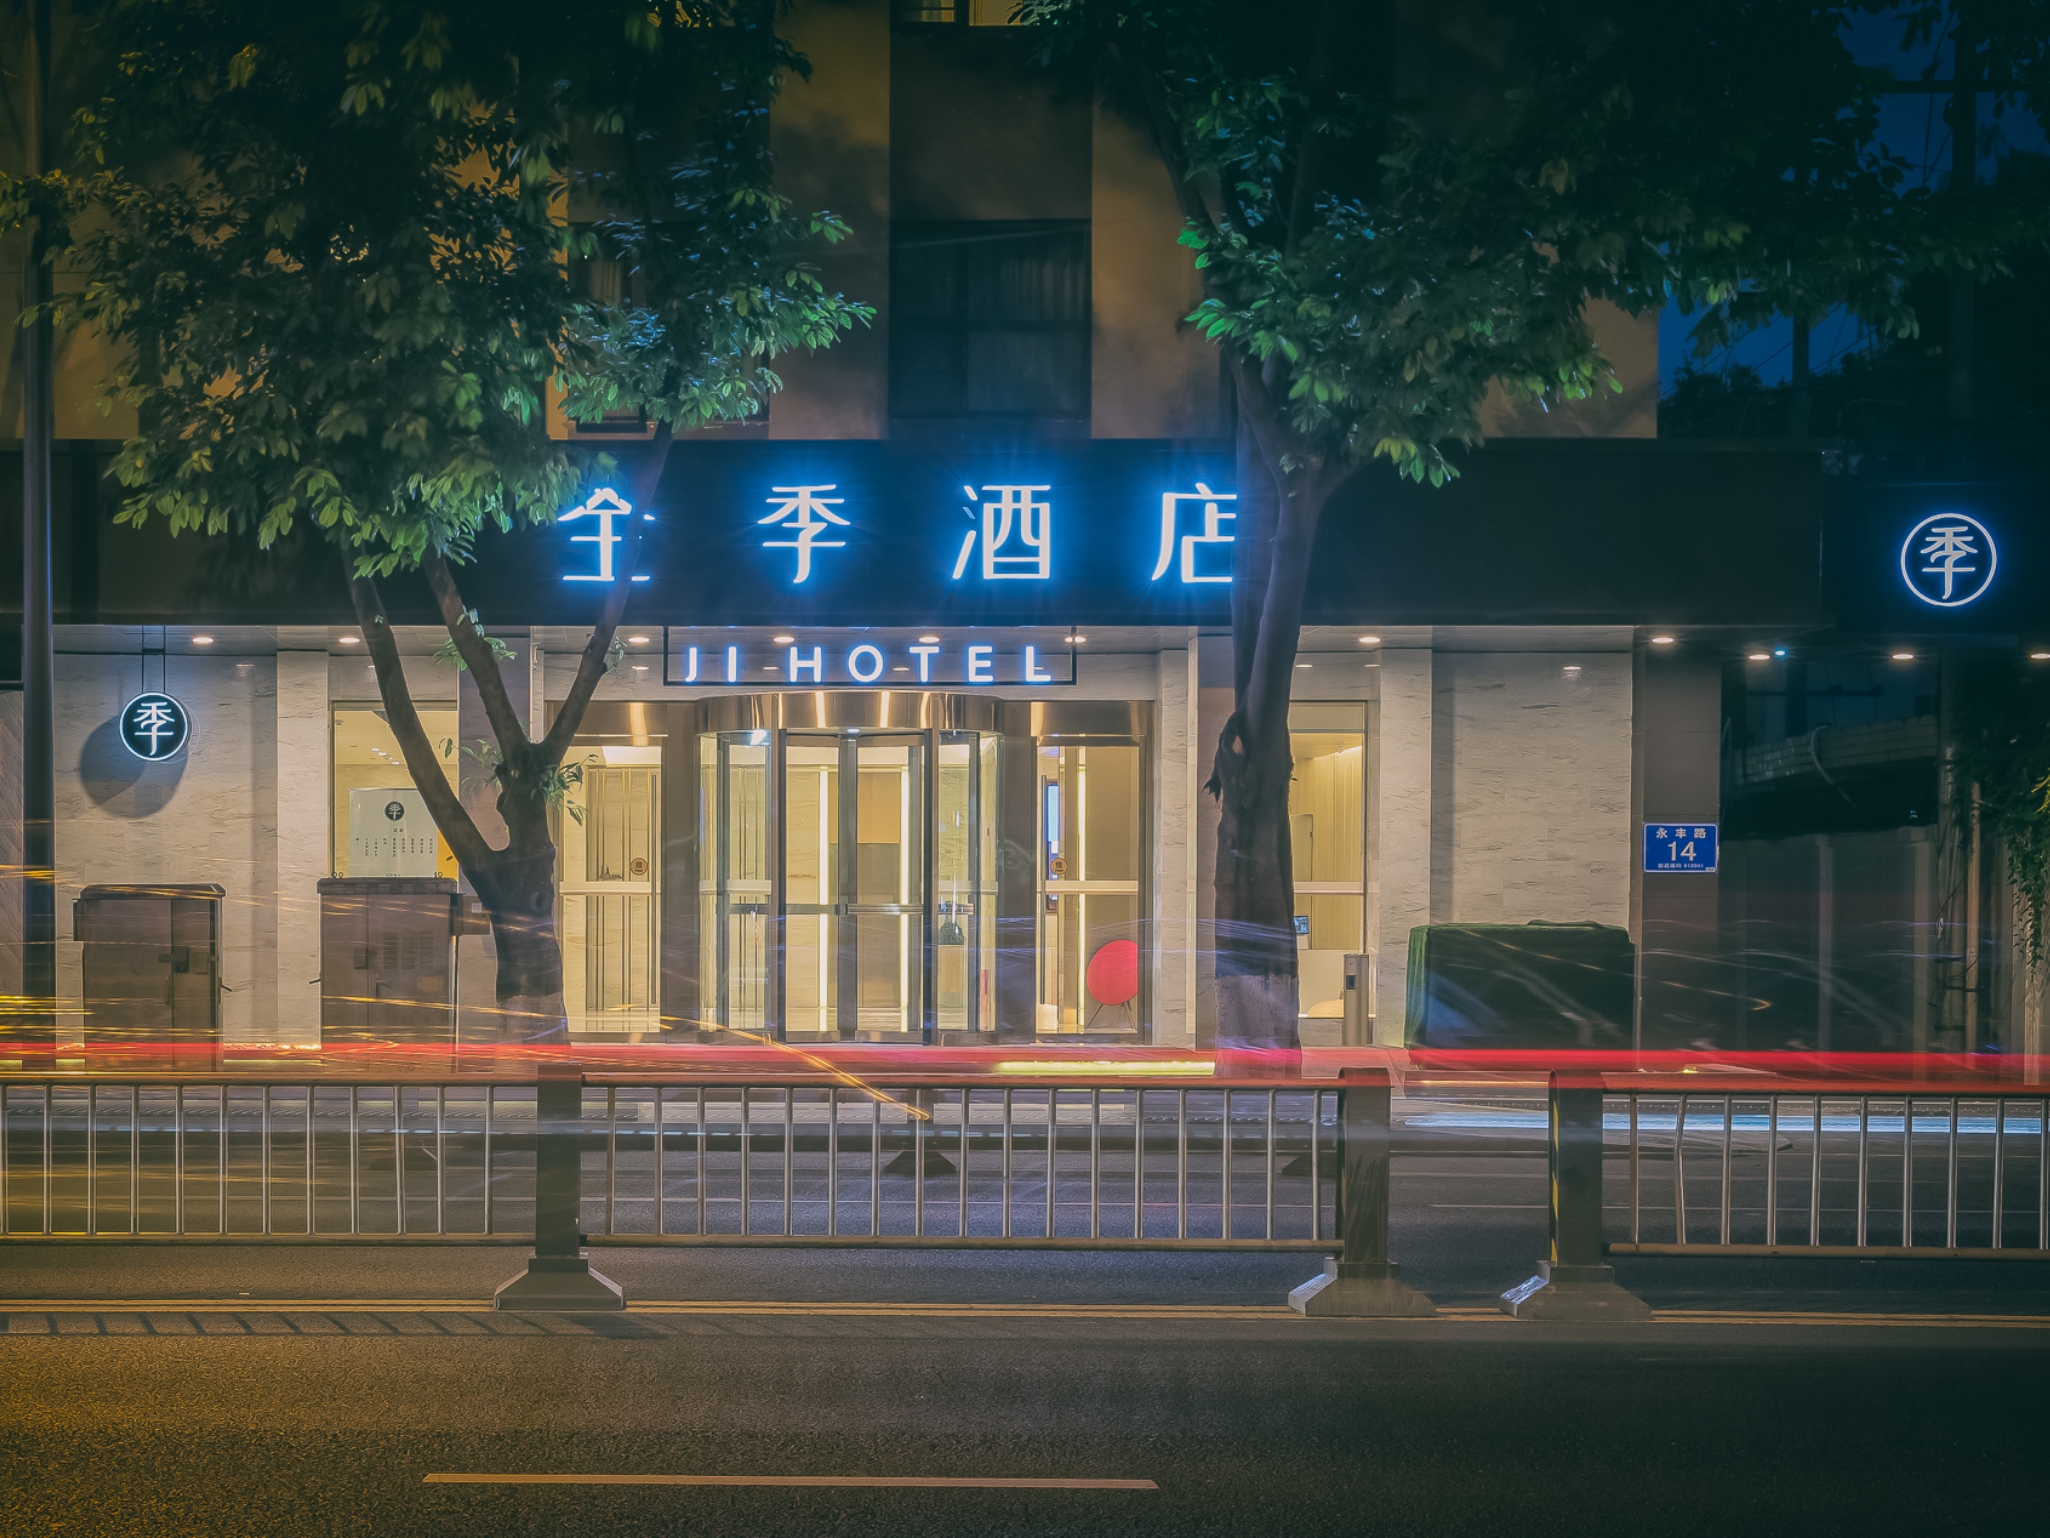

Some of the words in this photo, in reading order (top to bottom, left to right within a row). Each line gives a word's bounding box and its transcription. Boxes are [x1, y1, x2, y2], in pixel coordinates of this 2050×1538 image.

[557, 483, 1237, 583] 全季酒店
[1920, 526, 1978, 600] 季
[684, 646, 738, 683] JI
[789, 644, 1051, 683] HOTEL
[133, 701, 175, 756] 季
[1655, 827, 1706, 839] 永丰路
[1667, 841, 1697, 861] 14
